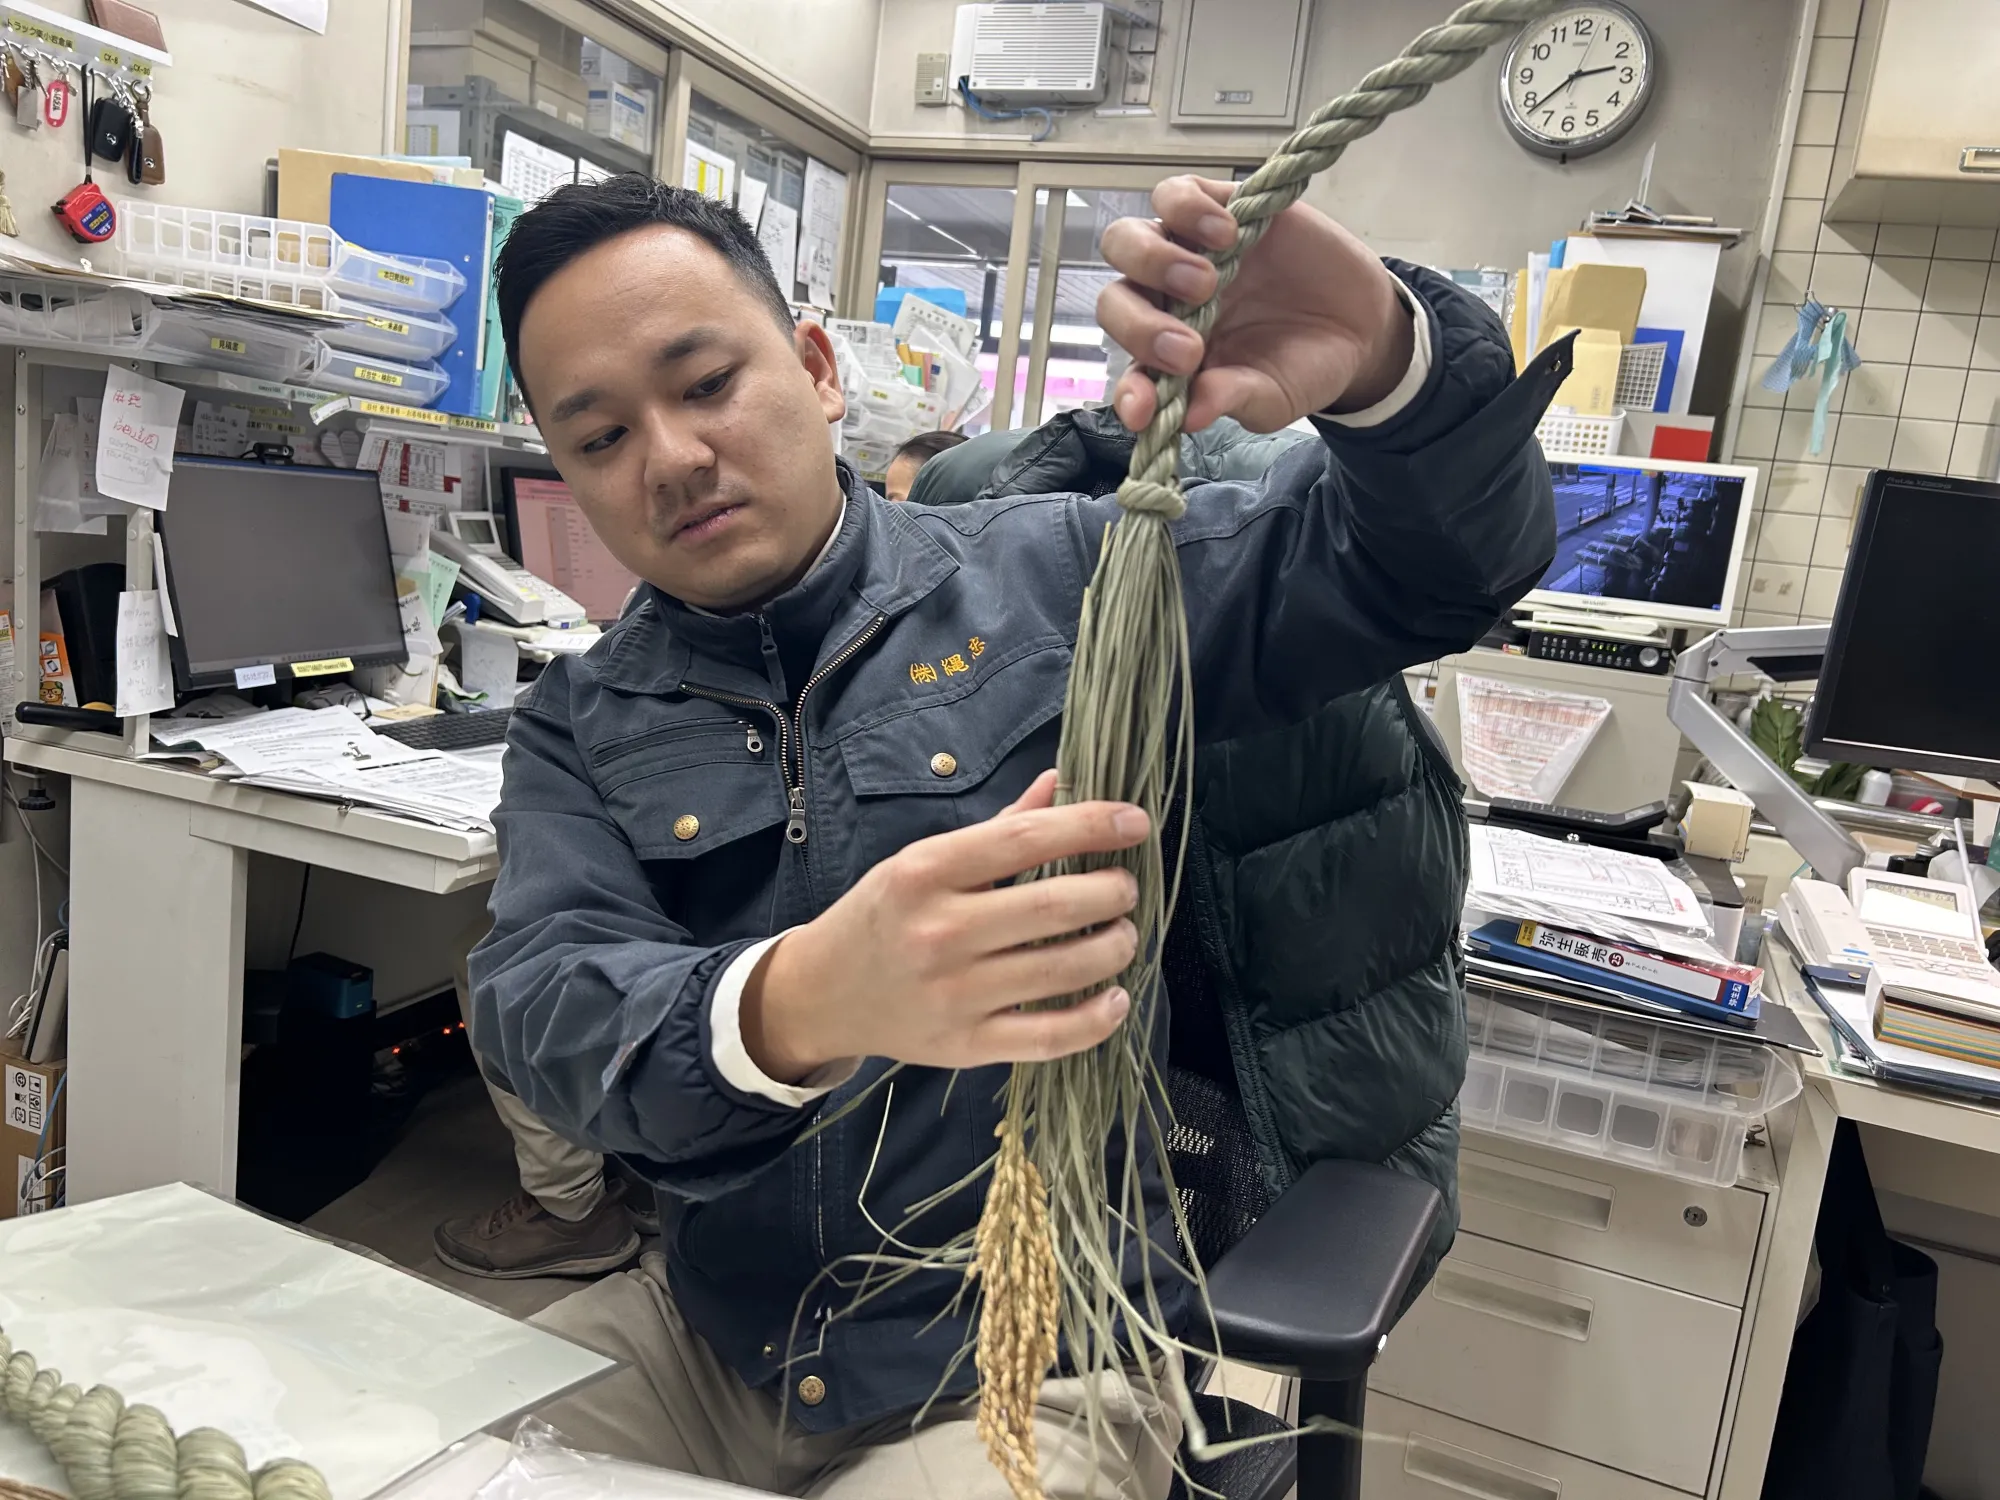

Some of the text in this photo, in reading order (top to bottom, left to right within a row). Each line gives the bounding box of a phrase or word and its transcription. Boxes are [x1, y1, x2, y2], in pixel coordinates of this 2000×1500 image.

[1551, 26, 1567, 43] 11
[1574, 18, 1593, 36] 12
[1604, 25, 1611, 42] 1
[103, 53, 119, 65] CX-8
[1531, 43, 1551, 61] 10
[1614, 41, 1630, 59] 2
[1519, 67, 1534, 85] 9
[1619, 66, 1634, 84] 3
[1523, 91, 1538, 108] 8
[1606, 90, 1621, 107] 4
[1542, 110, 1555, 127] 7
[1561, 115, 1575, 133] 6
[1584, 109, 1599, 127] 5
[218, 342, 239, 352] 見積書
[1538, 932, 1608, 963] 弥生販売
[1610, 953, 1624, 967] 25
